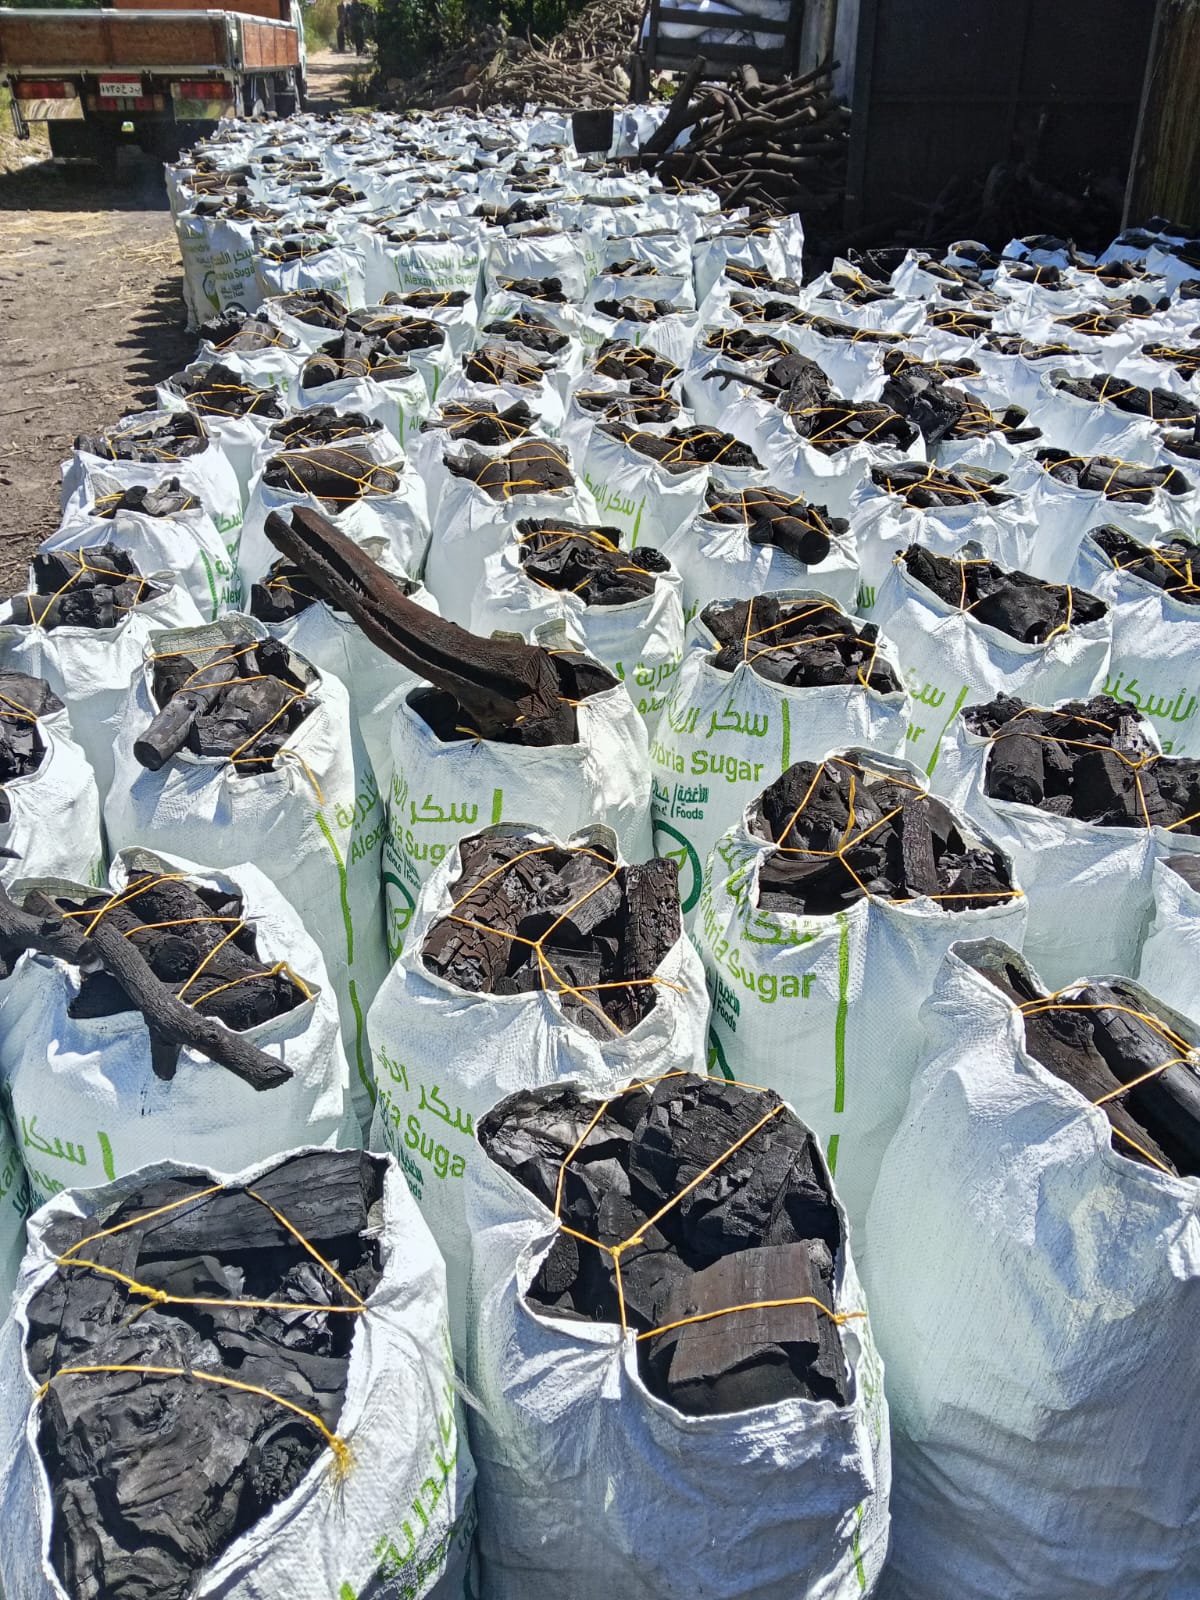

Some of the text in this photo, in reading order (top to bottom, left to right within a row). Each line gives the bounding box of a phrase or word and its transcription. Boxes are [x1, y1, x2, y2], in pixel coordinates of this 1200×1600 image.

[705, 699, 769, 739] سكر
[690, 749, 765, 783] Sugar
[410, 794, 478, 826] سكر
[676, 806, 704, 820] Foods
[726, 948, 817, 1004] Sugar
[21, 1115, 87, 1167] سكر
